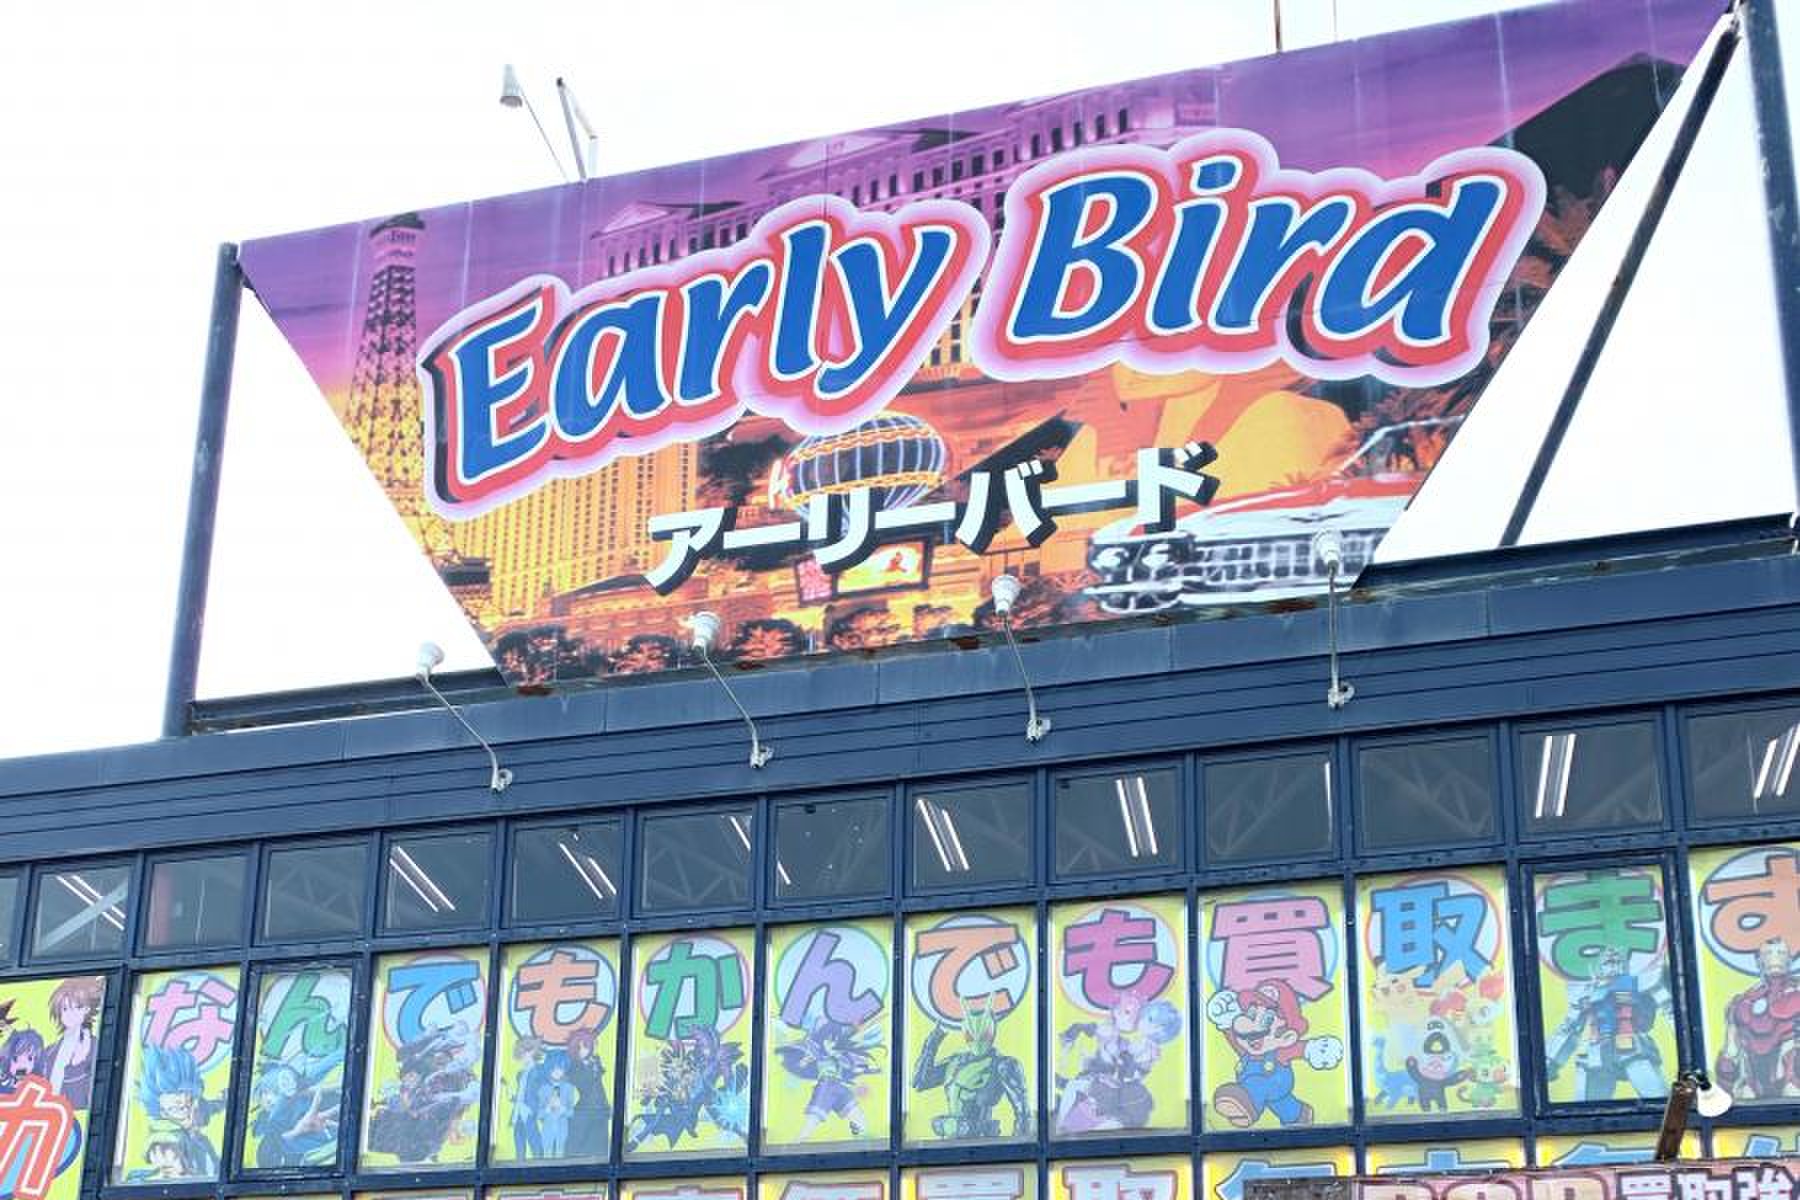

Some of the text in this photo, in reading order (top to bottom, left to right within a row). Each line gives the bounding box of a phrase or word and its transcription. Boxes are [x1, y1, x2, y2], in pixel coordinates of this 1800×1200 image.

[442, 145, 1516, 492] Early Bird
[645, 440, 1220, 592] アーリーバード
